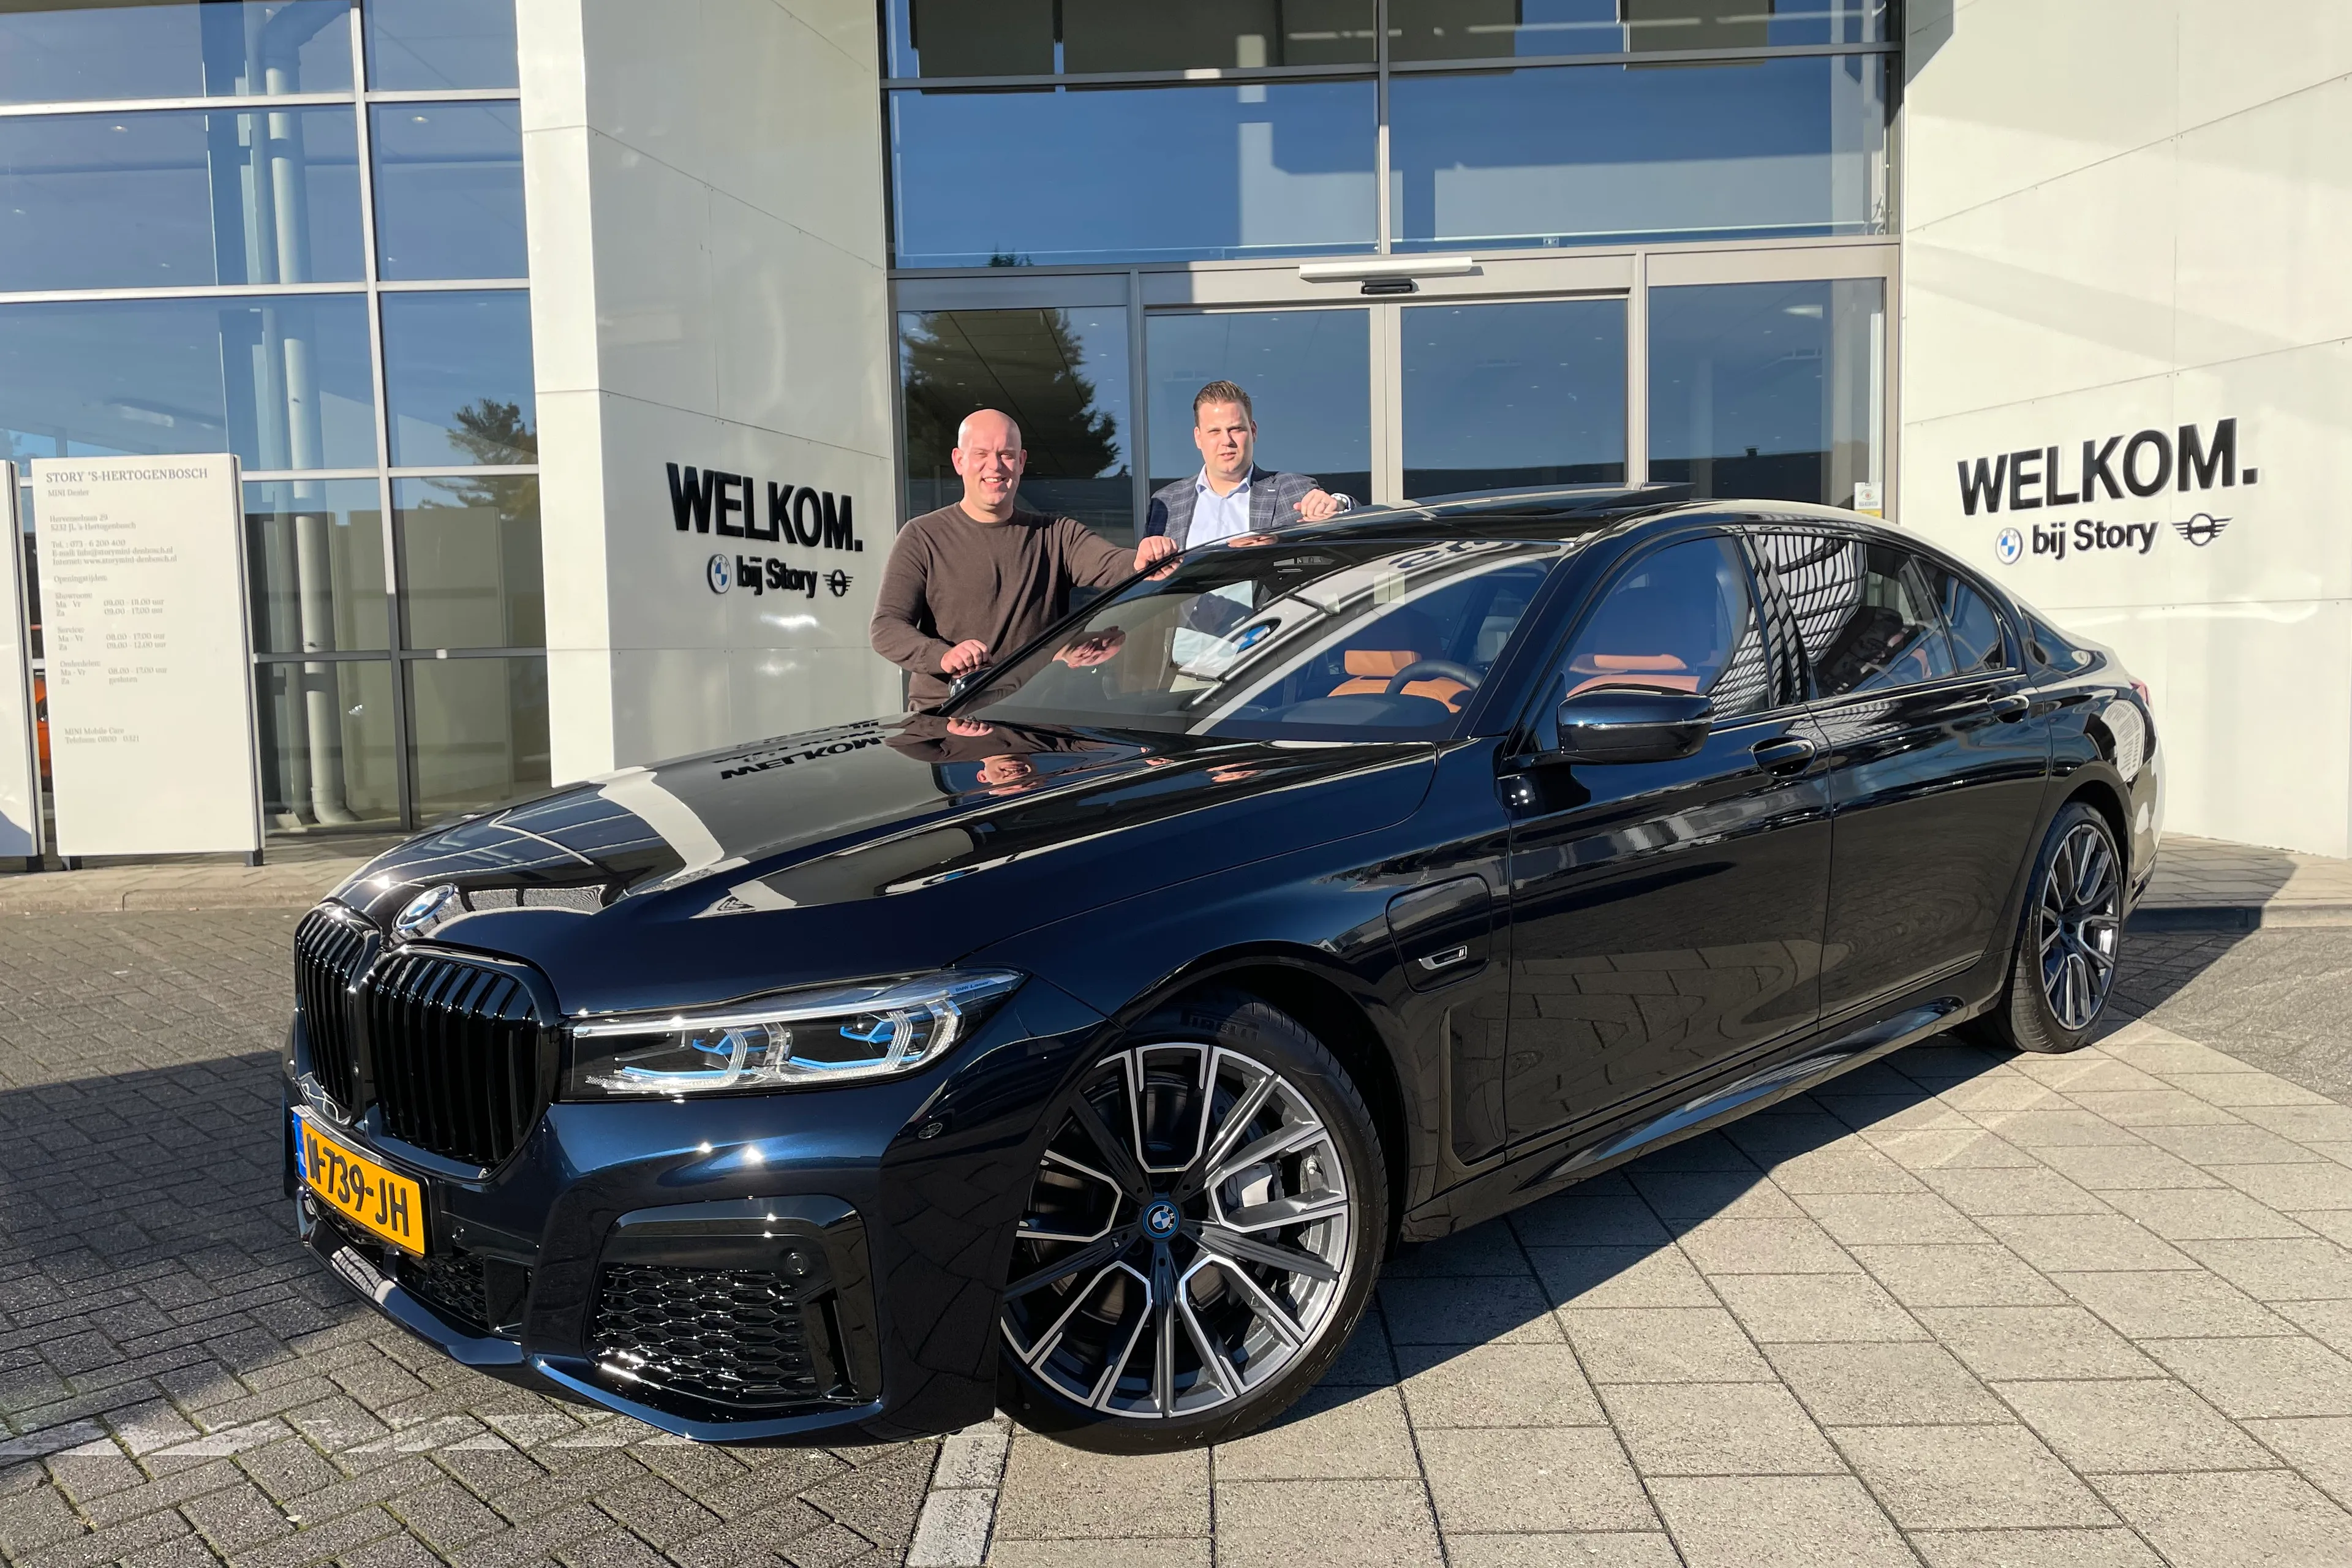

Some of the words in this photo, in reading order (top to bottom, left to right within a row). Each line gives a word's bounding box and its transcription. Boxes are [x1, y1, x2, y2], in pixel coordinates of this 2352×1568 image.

[46, 472, 84, 483] STORY
[88, 468, 208, 482] 'S-HERTOGENBOSCH
[1957, 417, 2258, 516] WELKOM.
[666, 462, 864, 552] WELKOM.
[2032, 521, 2066, 560] bij
[2073, 519, 2160, 555] Story
[736, 554, 763, 595] bij
[766, 557, 818, 598] Story
[83, 726, 107, 735] Mobile
[1179, 1008, 1260, 1042] PIRELLI
